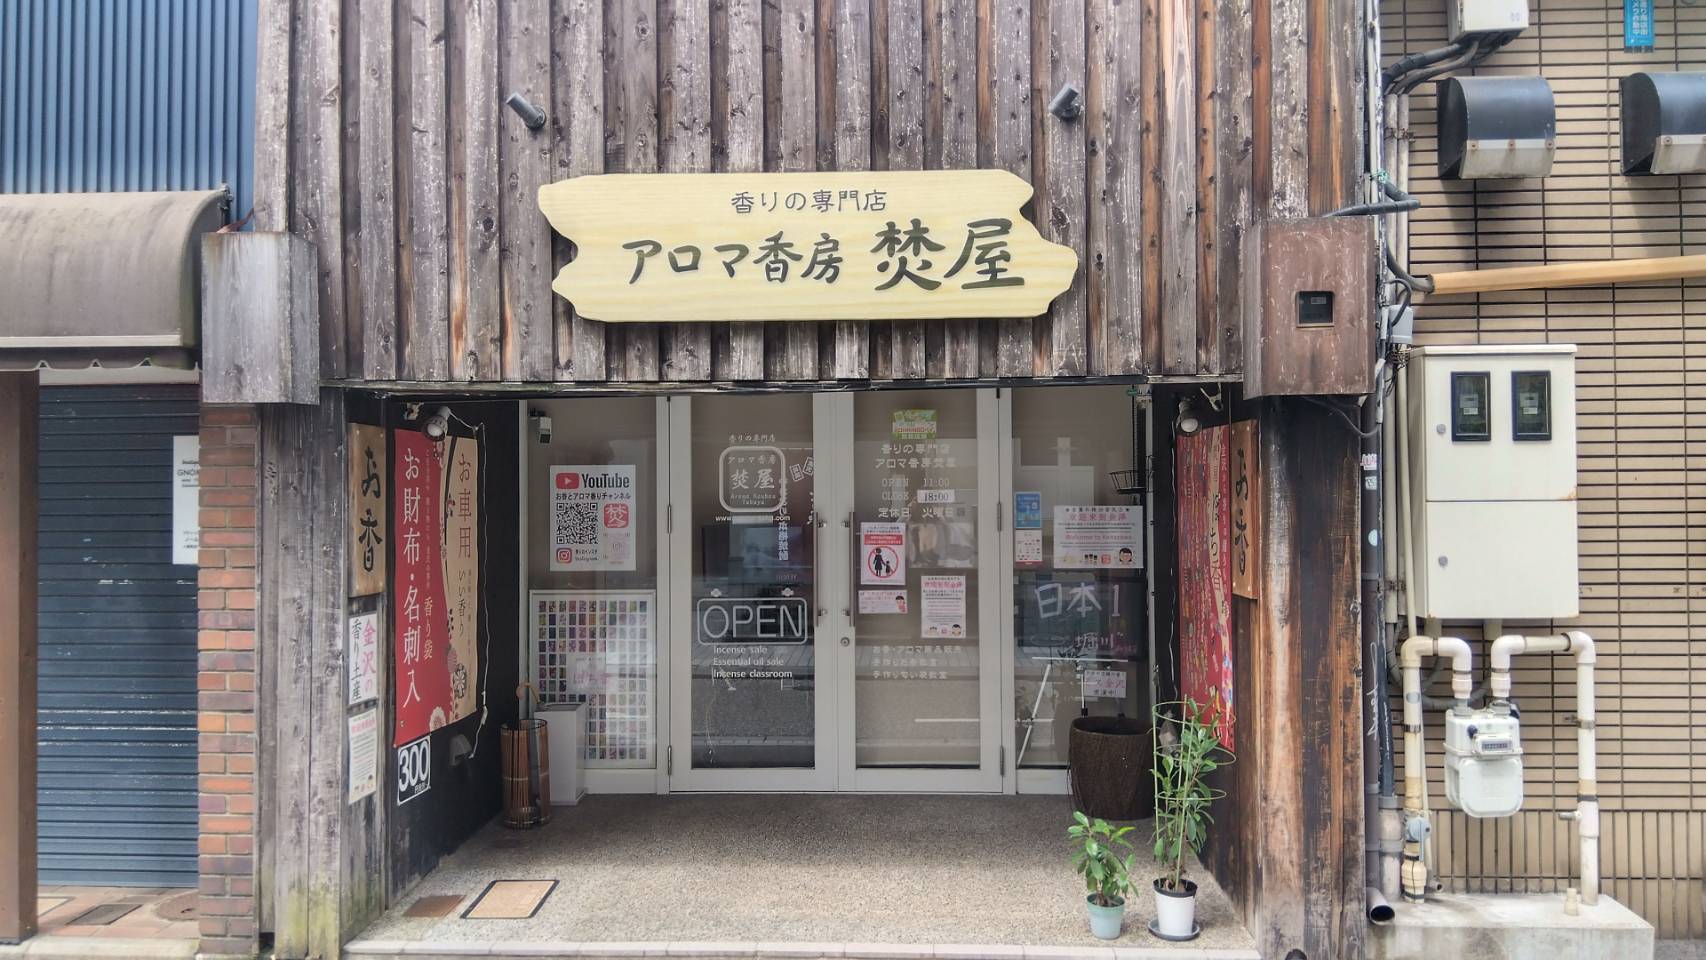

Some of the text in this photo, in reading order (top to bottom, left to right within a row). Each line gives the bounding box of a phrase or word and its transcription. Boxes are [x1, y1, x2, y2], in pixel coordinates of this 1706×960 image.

[731, 190, 888, 212] 香りの専門店
[622, 217, 1024, 291] アロマ香房 焚屋
[881, 444, 950, 455] 香りの専門店
[581, 473, 630, 489] YouTube
[730, 468, 775, 489] 焚屋
[458, 452, 472, 558] お車用
[924, 492, 949, 500] 18:00
[878, 507, 954, 518] 定休日 火曜日
[703, 604, 802, 638] OPEN
[363, 618, 376, 693] 金沢の
[713, 645, 768, 654] Incense sale
[713, 657, 751, 666] Essential
[767, 657, 784, 666] sale
[713, 669, 792, 678] Incense classroom
[400, 740, 429, 792] 300
